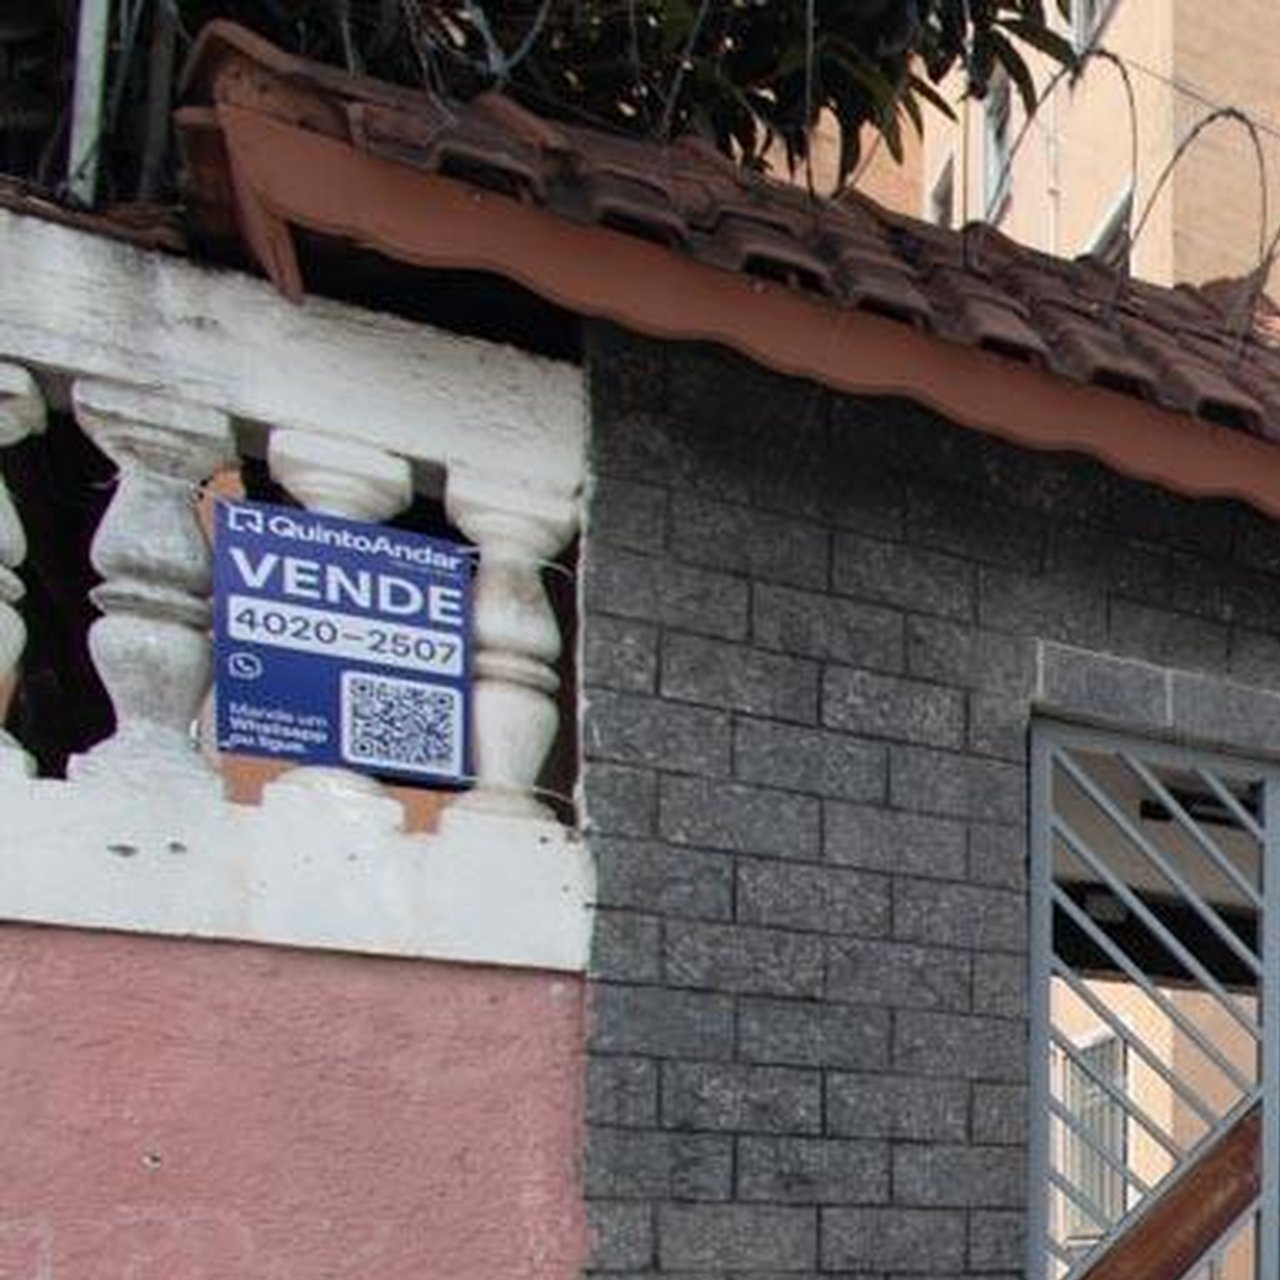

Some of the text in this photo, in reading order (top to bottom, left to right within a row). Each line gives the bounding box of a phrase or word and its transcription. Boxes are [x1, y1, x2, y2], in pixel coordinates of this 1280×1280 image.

[268, 516, 462, 571] QuintoAndar
[229, 548, 463, 626] VENDE
[234, 608, 458, 665] 4020-2507
